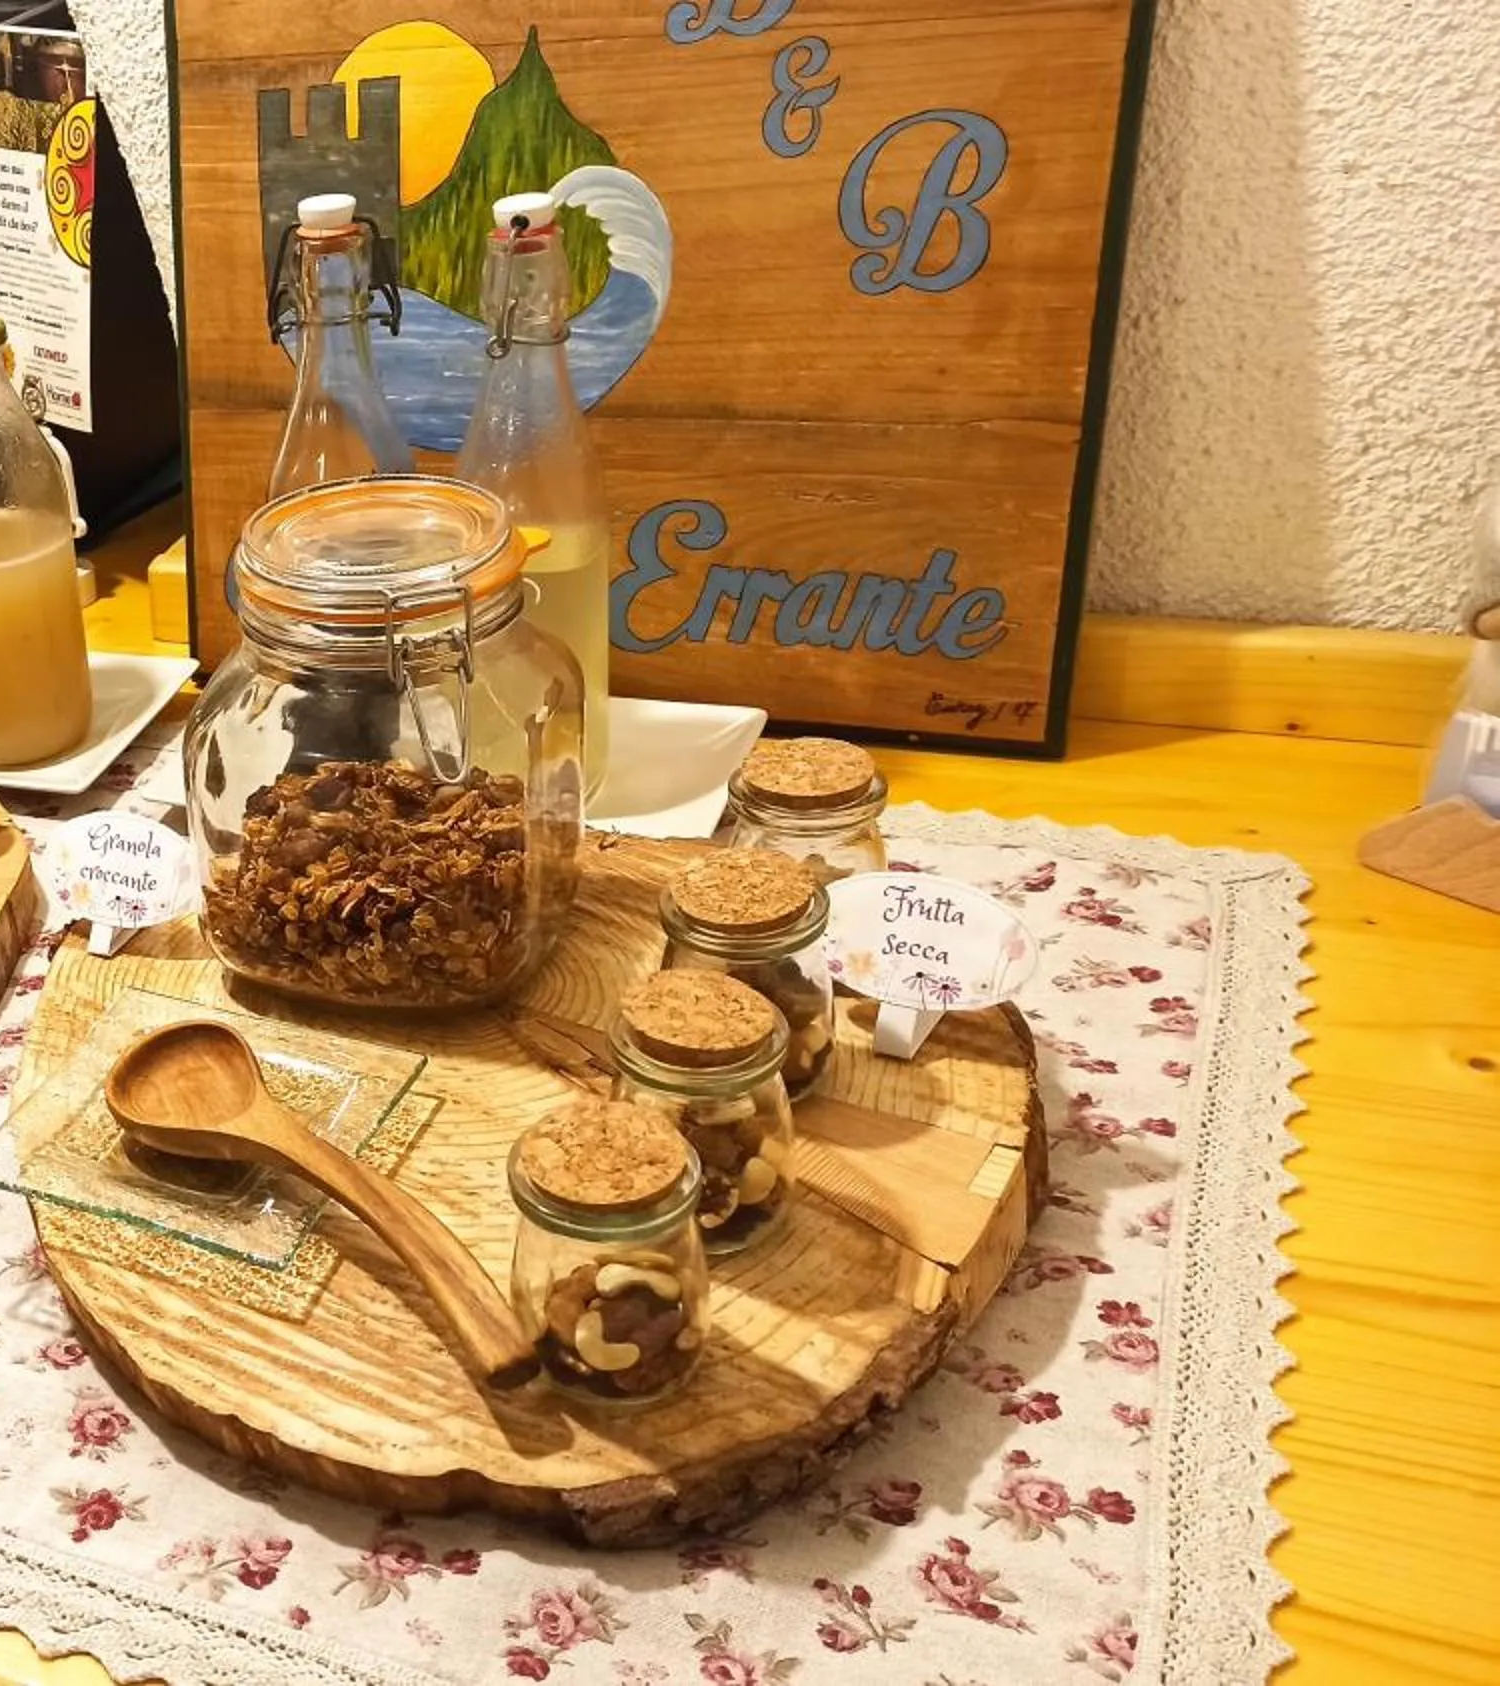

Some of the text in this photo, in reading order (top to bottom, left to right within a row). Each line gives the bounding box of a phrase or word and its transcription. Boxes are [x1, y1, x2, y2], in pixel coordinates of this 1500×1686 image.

[761, 35, 841, 159] &
[837, 107, 1009, 296] B
[608, 499, 1009, 660] Errante
[79, 864, 158, 893] croccante
[87, 822, 162, 859] Granola
[882, 884, 965, 926] Frutta
